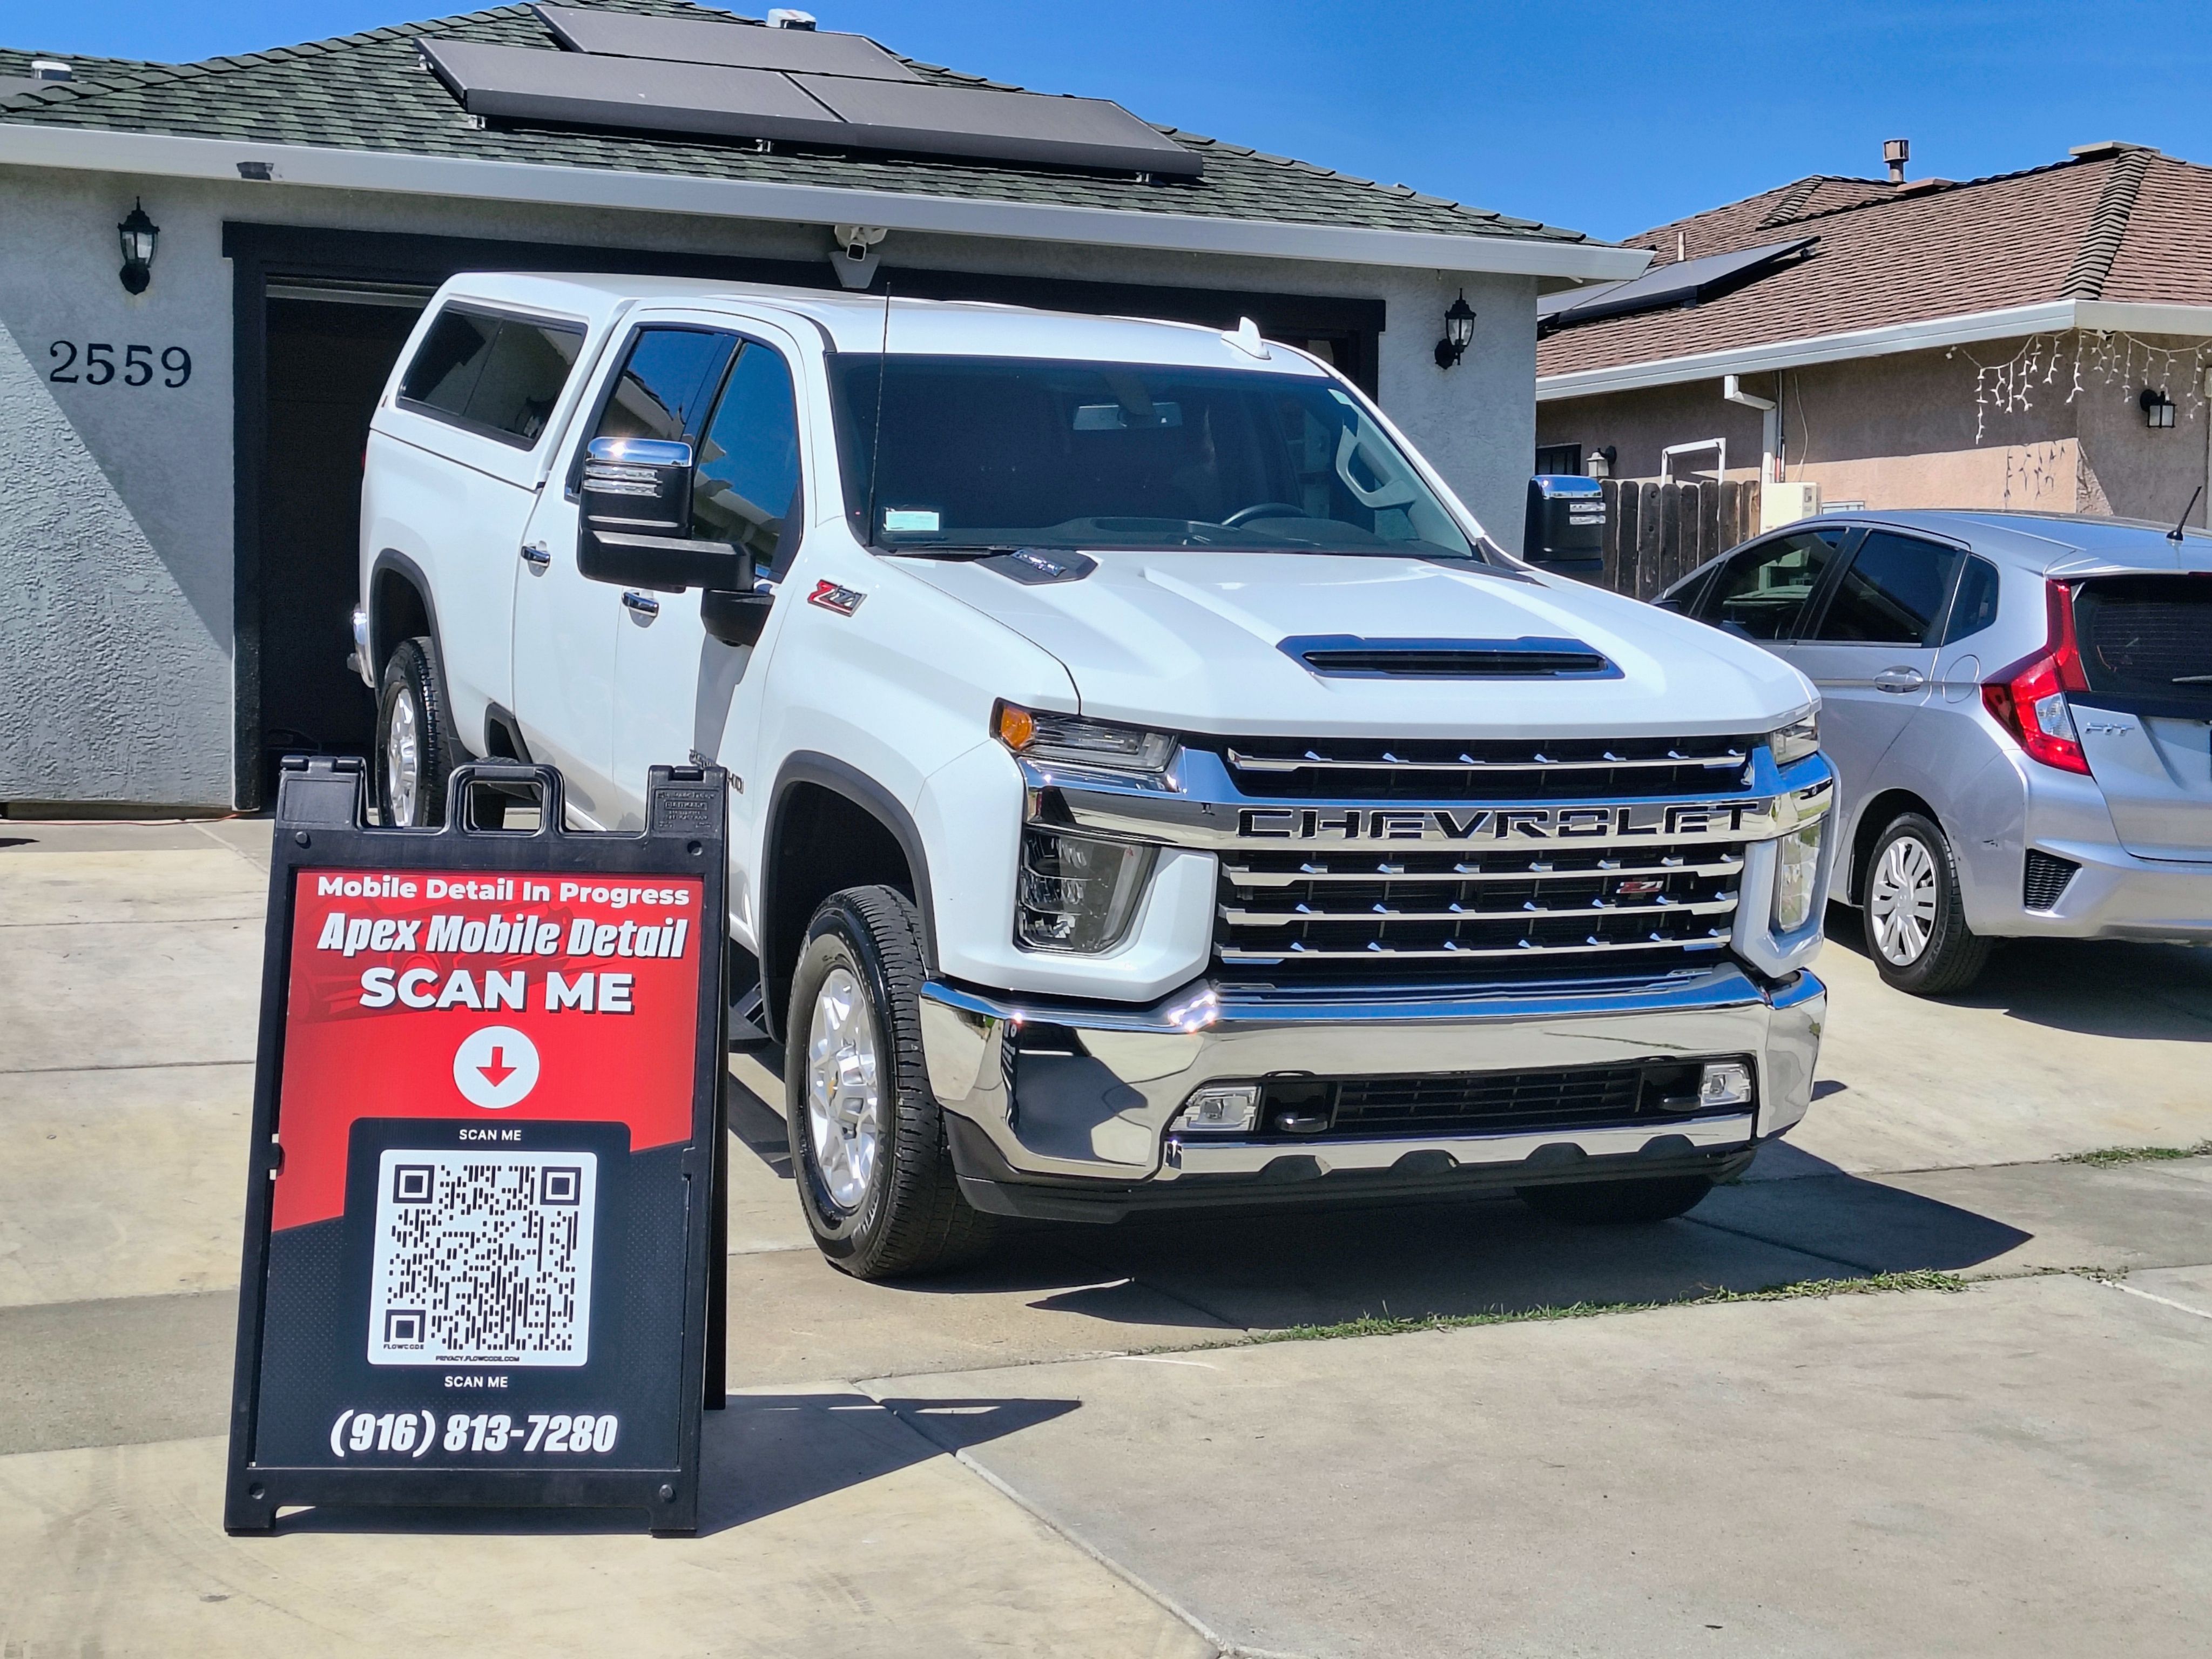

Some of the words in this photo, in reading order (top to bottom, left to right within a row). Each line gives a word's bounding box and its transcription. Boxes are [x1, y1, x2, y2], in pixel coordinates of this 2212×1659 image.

[50, 340, 192, 388] 2559
[1236, 801, 1759, 839] CHEVROLET
[318, 874, 417, 898] Mobile
[426, 878, 514, 901] Detail
[523, 881, 550, 902] In
[559, 882, 690, 908] Progress
[316, 912, 421, 957] Apex
[425, 913, 561, 955] Mobile
[567, 917, 689, 958] Detail
[359, 967, 526, 1010] SCAN
[545, 972, 633, 1013] ME
[459, 1128, 497, 1141] SCAN
[501, 1129, 522, 1142] ME
[444, 1375, 483, 1388] SCAN
[488, 1376, 508, 1388] ME
[331, 1409, 436, 1458] (916)
[443, 1414, 618, 1453] 813-7280
